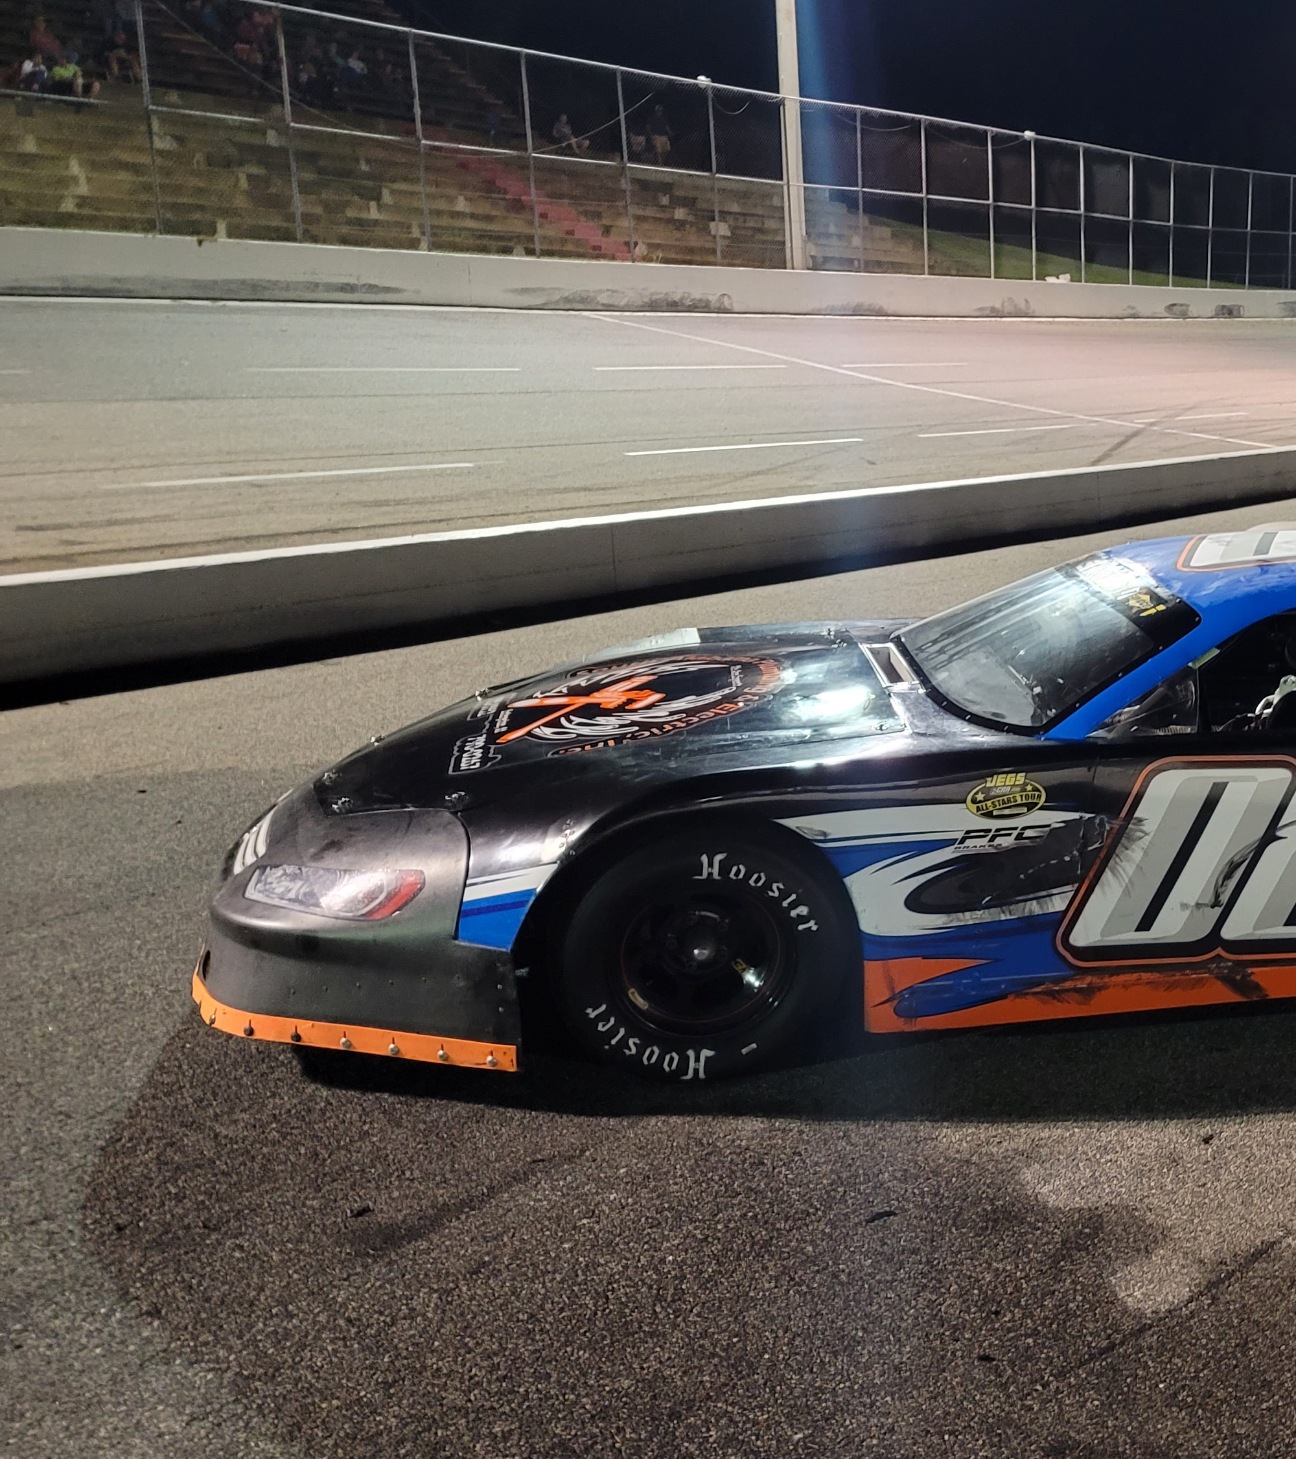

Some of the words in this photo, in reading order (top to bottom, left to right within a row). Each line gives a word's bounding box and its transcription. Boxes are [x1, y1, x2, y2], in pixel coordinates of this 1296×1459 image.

[975, 794, 1018, 813] ALL-STARS
[1018, 792, 1042, 802] TOUR
[986, 772, 1026, 787] JEGS
[692, 852, 819, 932] Hoosier
[585, 1003, 716, 1080] Hoosier
